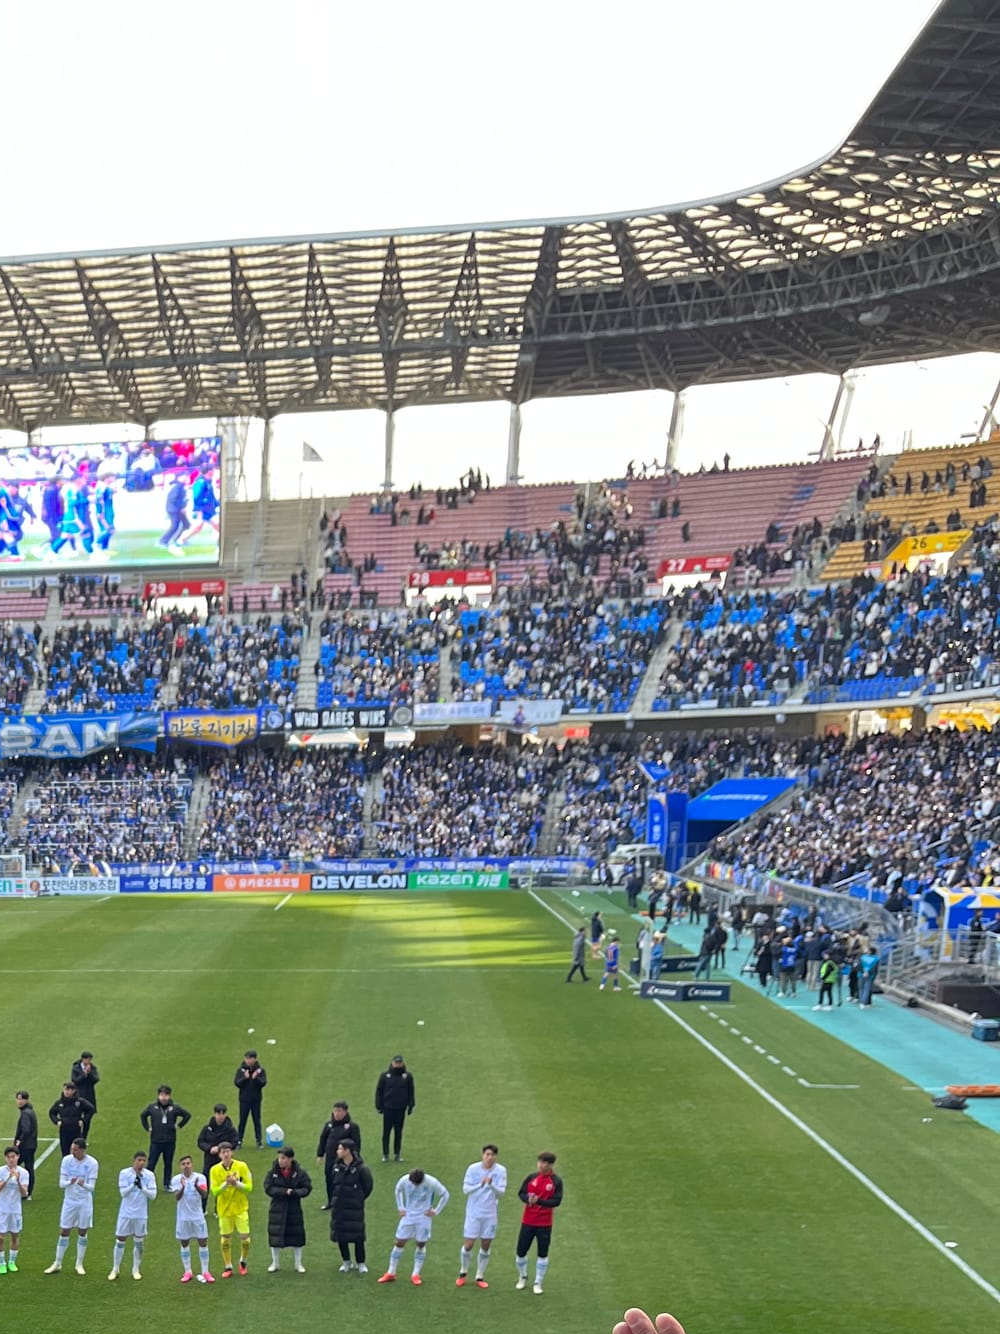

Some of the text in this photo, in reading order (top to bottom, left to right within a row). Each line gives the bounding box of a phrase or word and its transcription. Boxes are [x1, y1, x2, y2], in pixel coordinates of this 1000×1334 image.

[912, 536, 927, 550] 26
[667, 559, 687, 572] 27
[149, 583, 167, 595] 29
[294, 708, 386, 727] WHO DARES WINS
[311, 874, 407, 889] DEVELON
